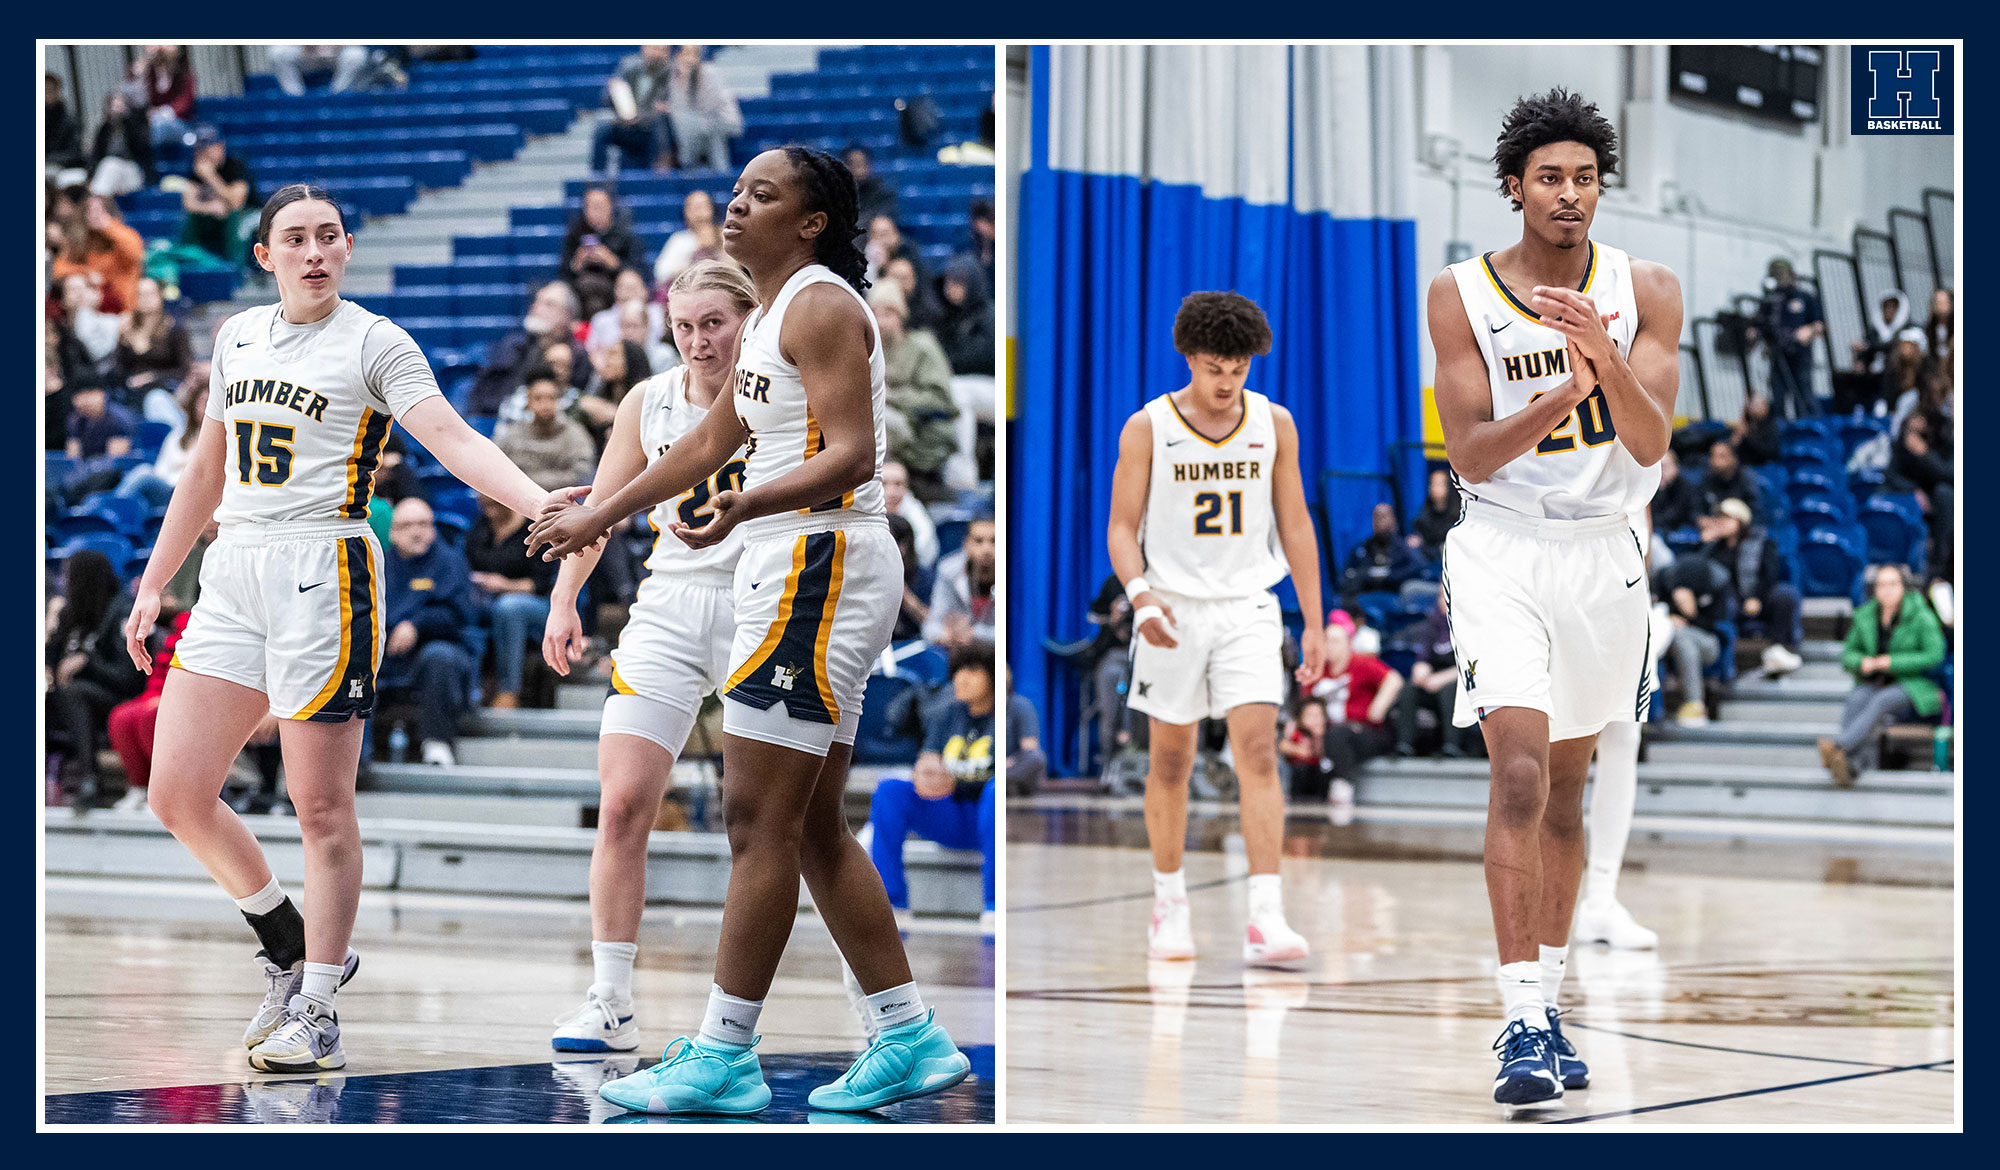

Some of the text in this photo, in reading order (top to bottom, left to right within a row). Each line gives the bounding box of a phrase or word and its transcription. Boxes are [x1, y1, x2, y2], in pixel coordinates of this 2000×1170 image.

[1501, 347, 1574, 382] HUM
[225, 379, 329, 423] HUMBER
[234, 419, 296, 488] 15
[1173, 461, 1261, 482] HUMBER
[1193, 490, 1244, 537] 21
